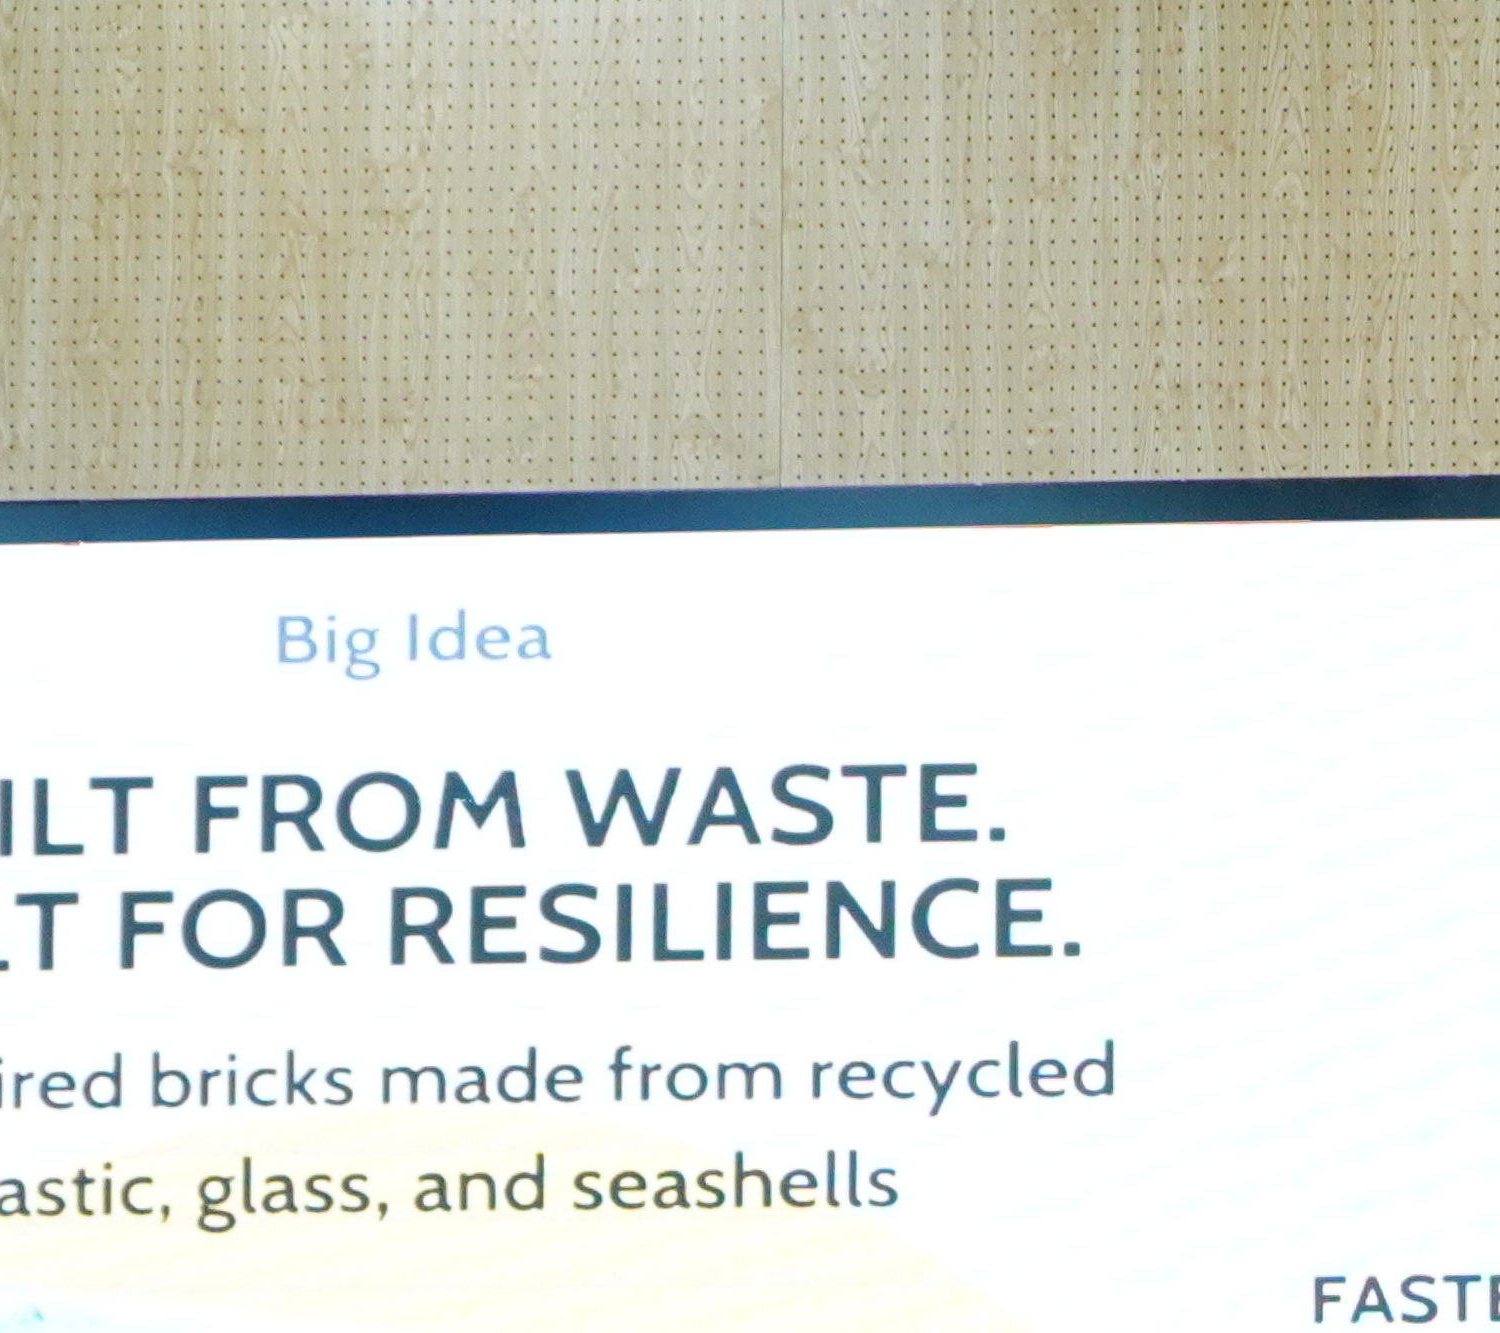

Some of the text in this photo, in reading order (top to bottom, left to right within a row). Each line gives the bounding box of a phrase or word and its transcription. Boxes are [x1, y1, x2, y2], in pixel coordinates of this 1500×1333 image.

[278, 609, 551, 680] Big Idea
[196, 771, 525, 853] FROM
[566, 763, 1005, 847] WASTE.
[121, 889, 346, 969] FOR
[391, 878, 1080, 965] RESILIENCE.
[153, 1050, 353, 1107] bricks
[383, 1047, 583, 1104] made
[609, 1045, 781, 1101] from
[813, 1039, 1113, 1116] recycled
[198, 1157, 387, 1233] glass,
[415, 1153, 544, 1211] and
[574, 1150, 898, 1210] seashells
